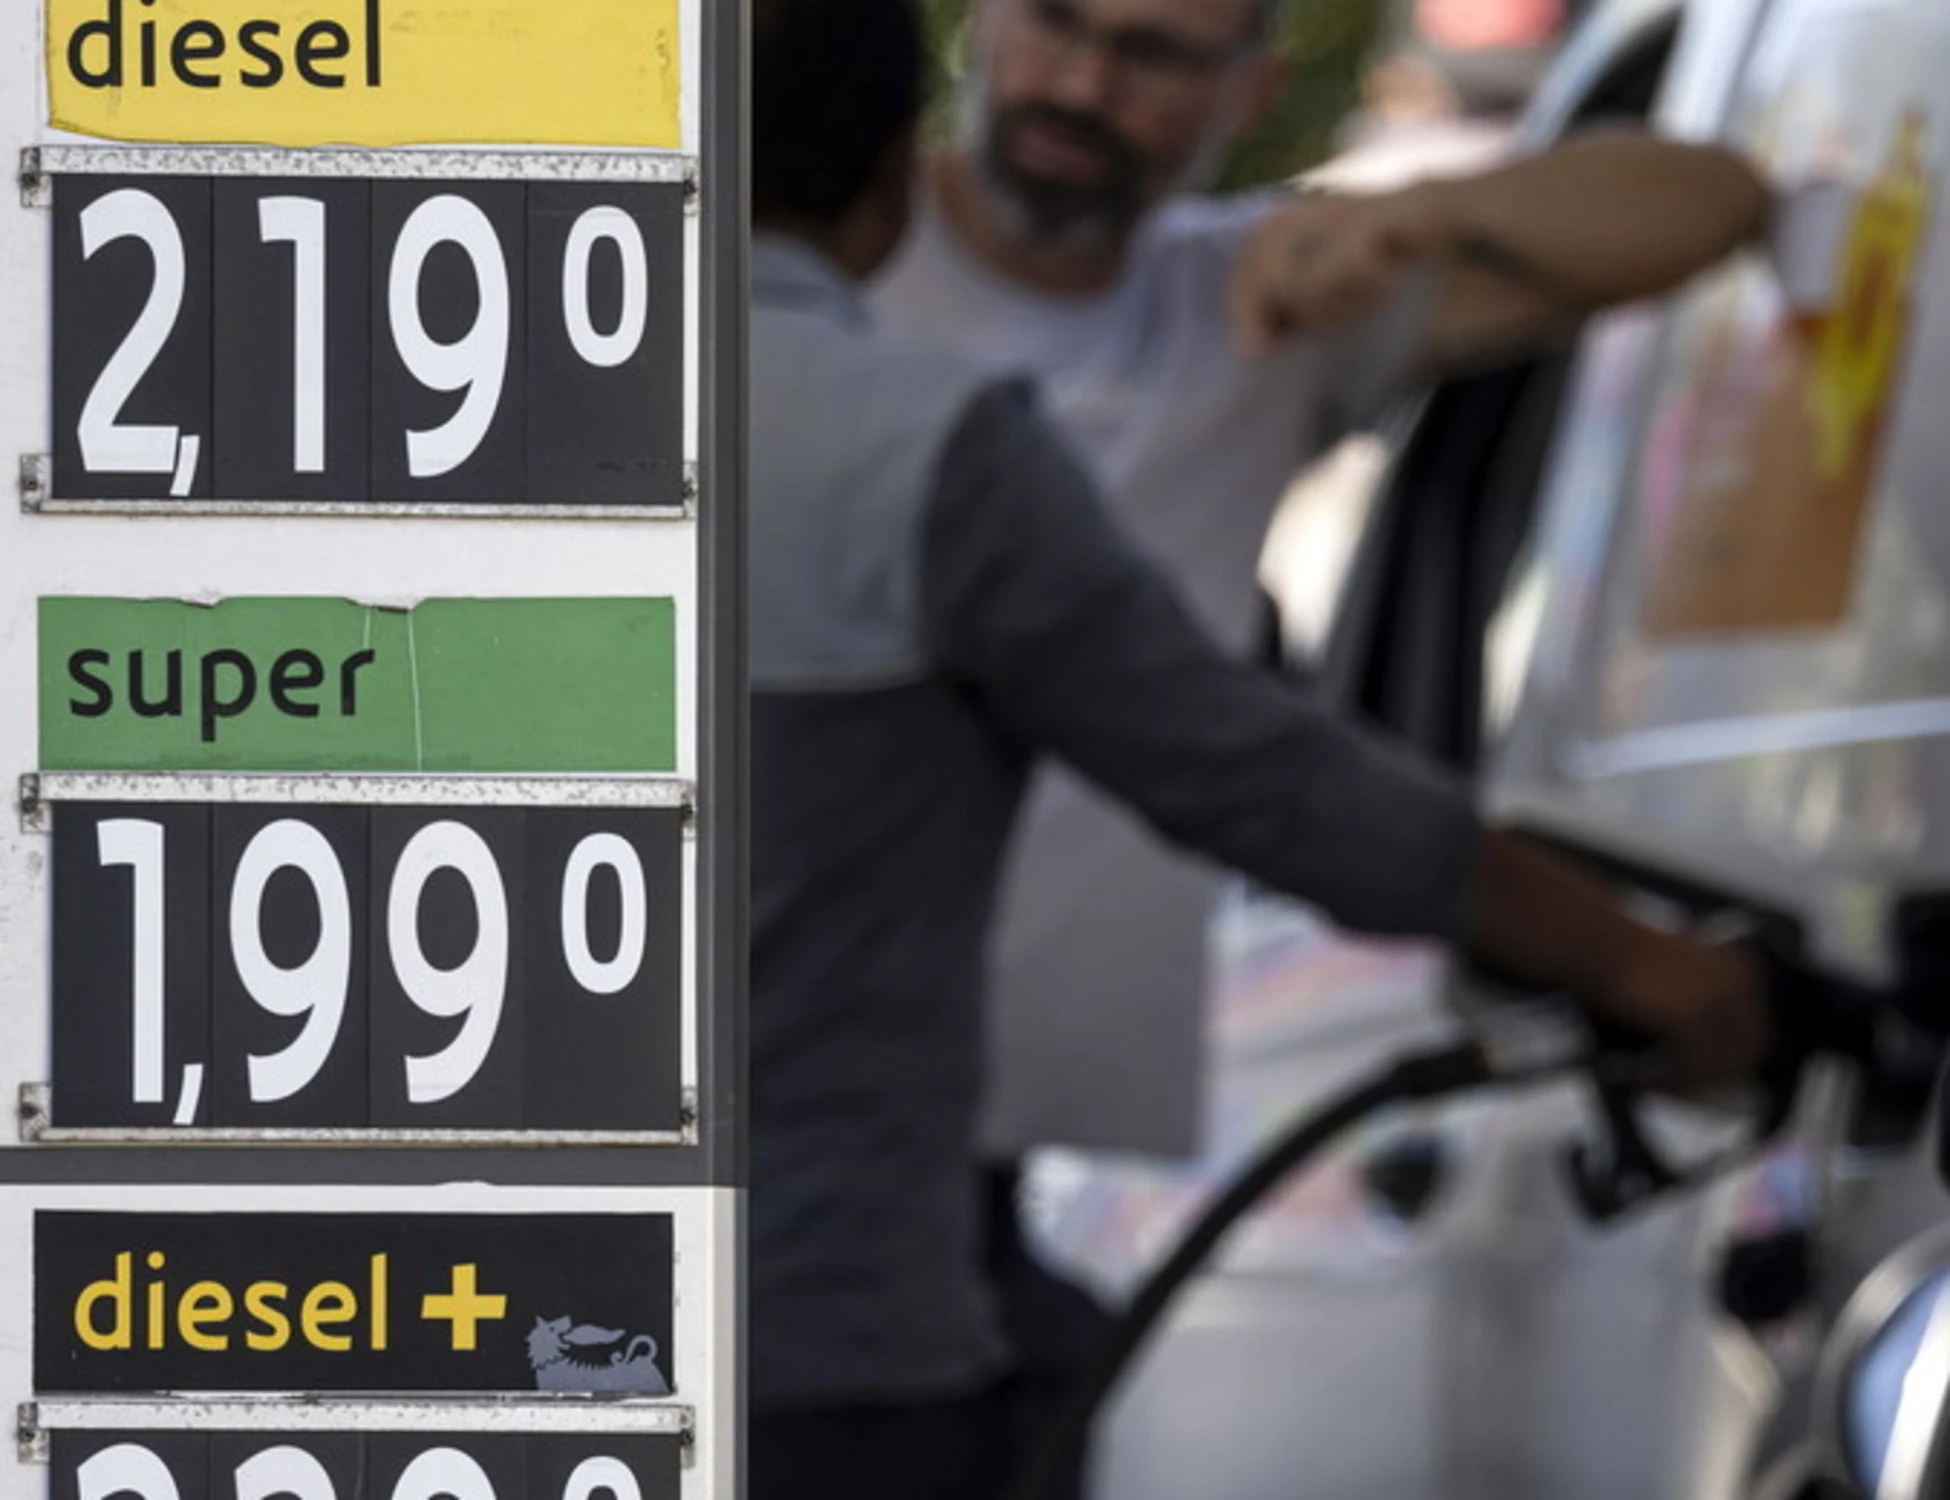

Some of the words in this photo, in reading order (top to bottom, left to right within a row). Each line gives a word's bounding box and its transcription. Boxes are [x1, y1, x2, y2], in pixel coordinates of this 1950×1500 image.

[68, 0, 379, 87] diesel
[68, 649, 374, 742] super
[75, 1252, 386, 1350] diesel
[421, 1264, 506, 1350] +
